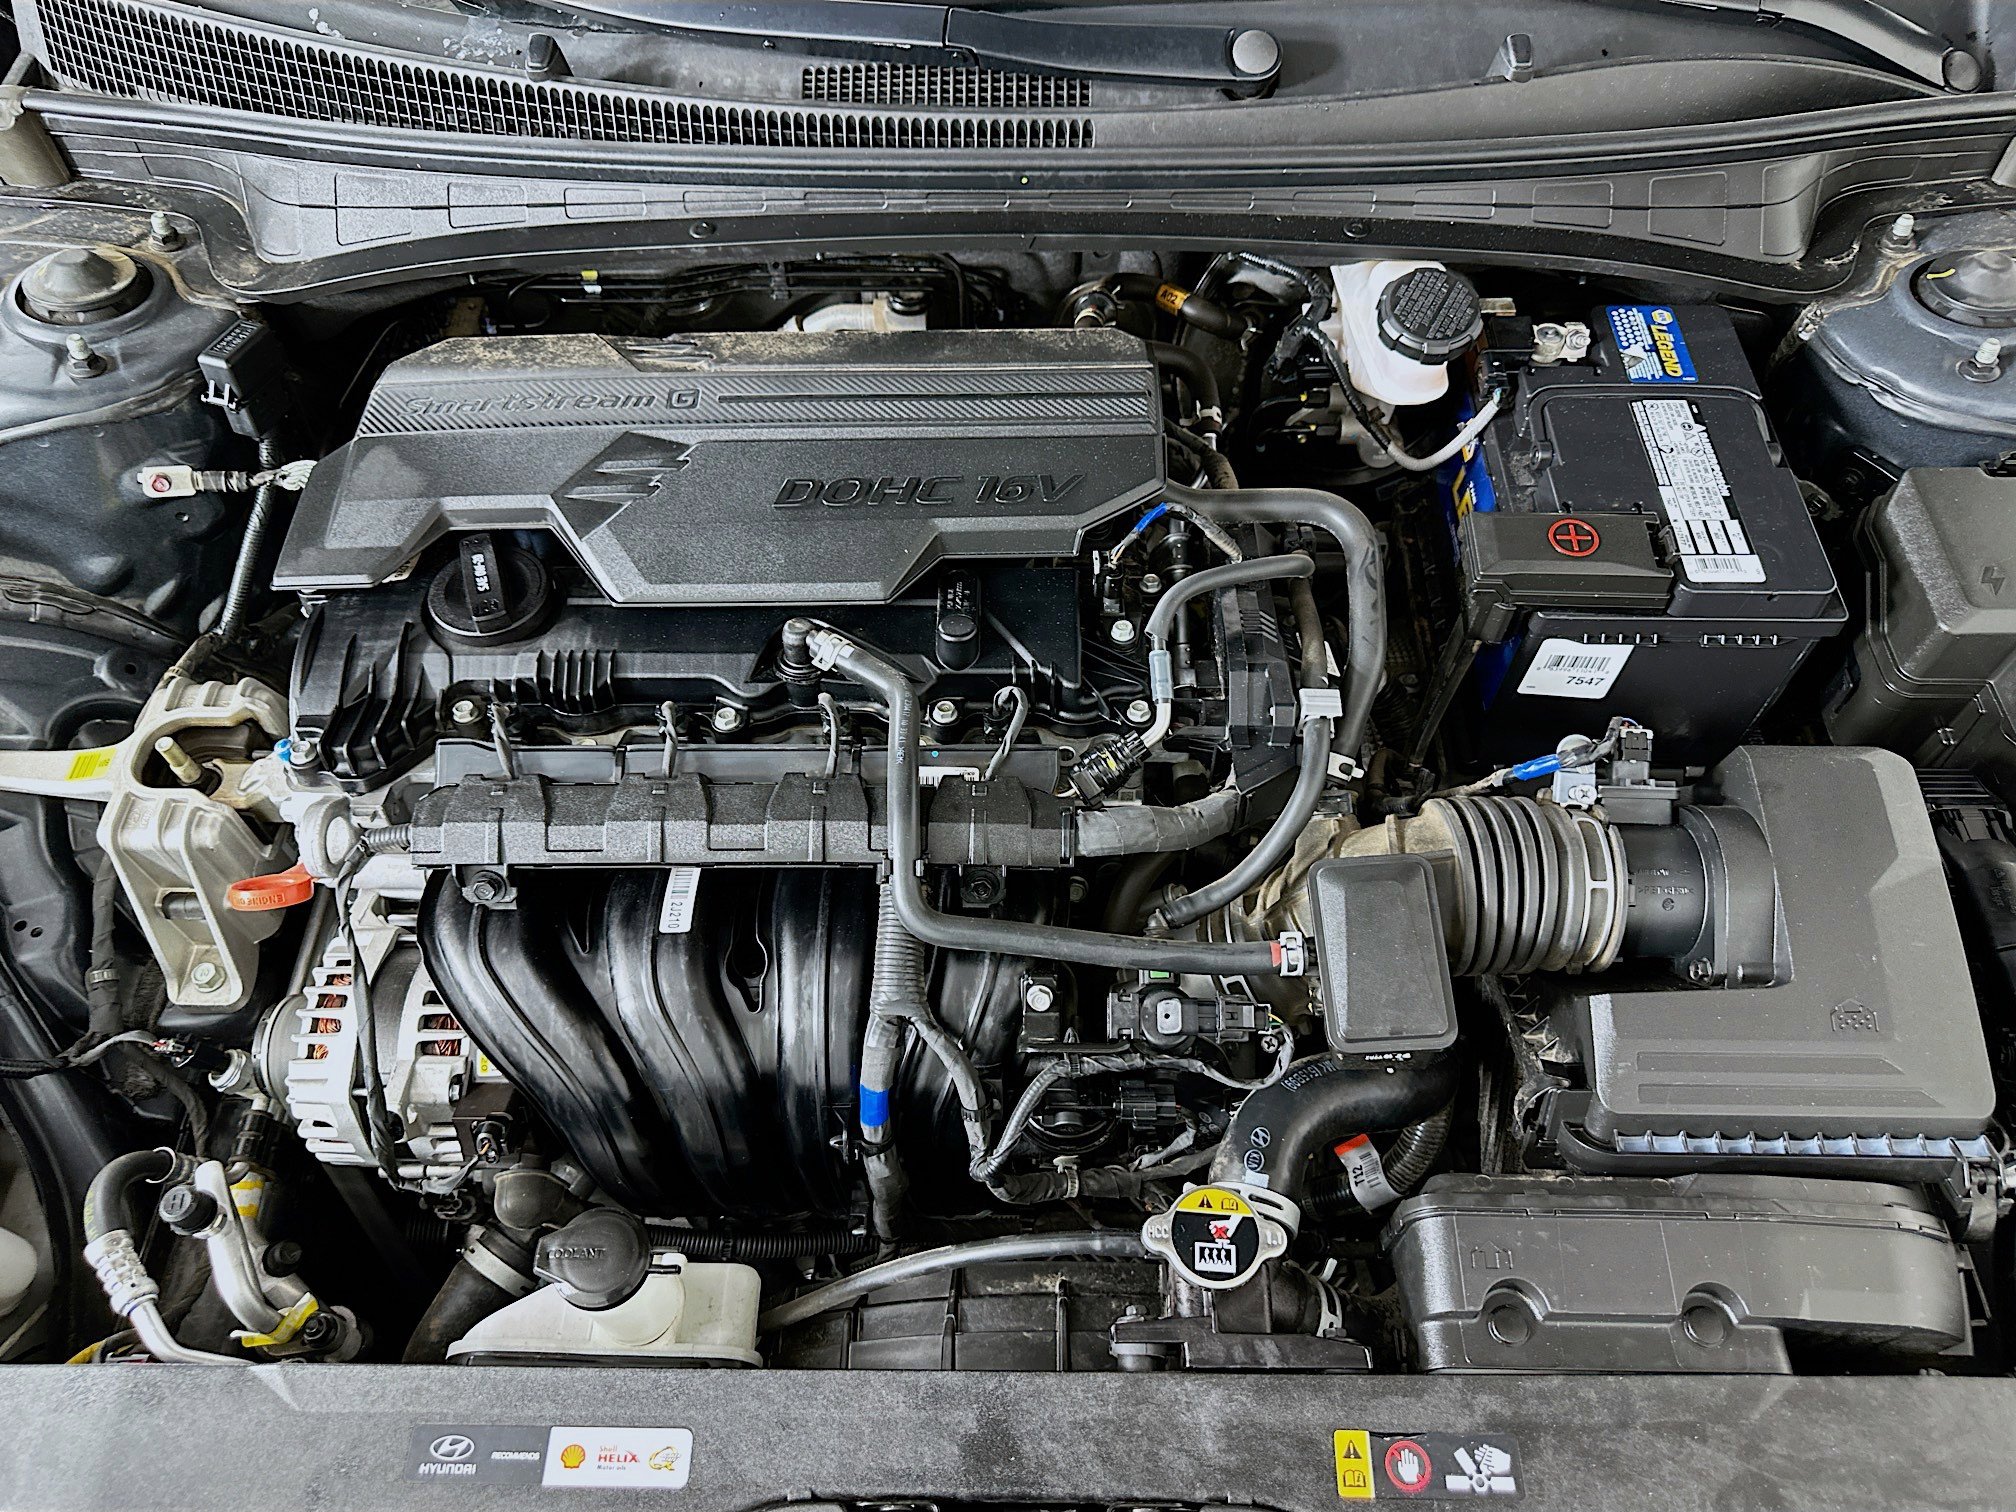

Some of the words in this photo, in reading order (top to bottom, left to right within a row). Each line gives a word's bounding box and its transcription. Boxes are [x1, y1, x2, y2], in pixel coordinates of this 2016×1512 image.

[1161, 289, 1178, 305] A02
[401, 392, 656, 416] Smartstream
[669, 389, 700, 409] G
[772, 476, 963, 507] DOHC
[975, 474, 1085, 504] 16V
[1566, 675, 1606, 687] 7547
[667, 901, 684, 929] 2J210
[1352, 1164, 1366, 1187] T12
[1147, 1225, 1170, 1239] HCC
[1266, 1231, 1282, 1245] 1.1
[547, 1247, 606, 1259] COOLANT
[598, 1451, 639, 1463] HELIX
[418, 1463, 477, 1475] HYUNDAI
